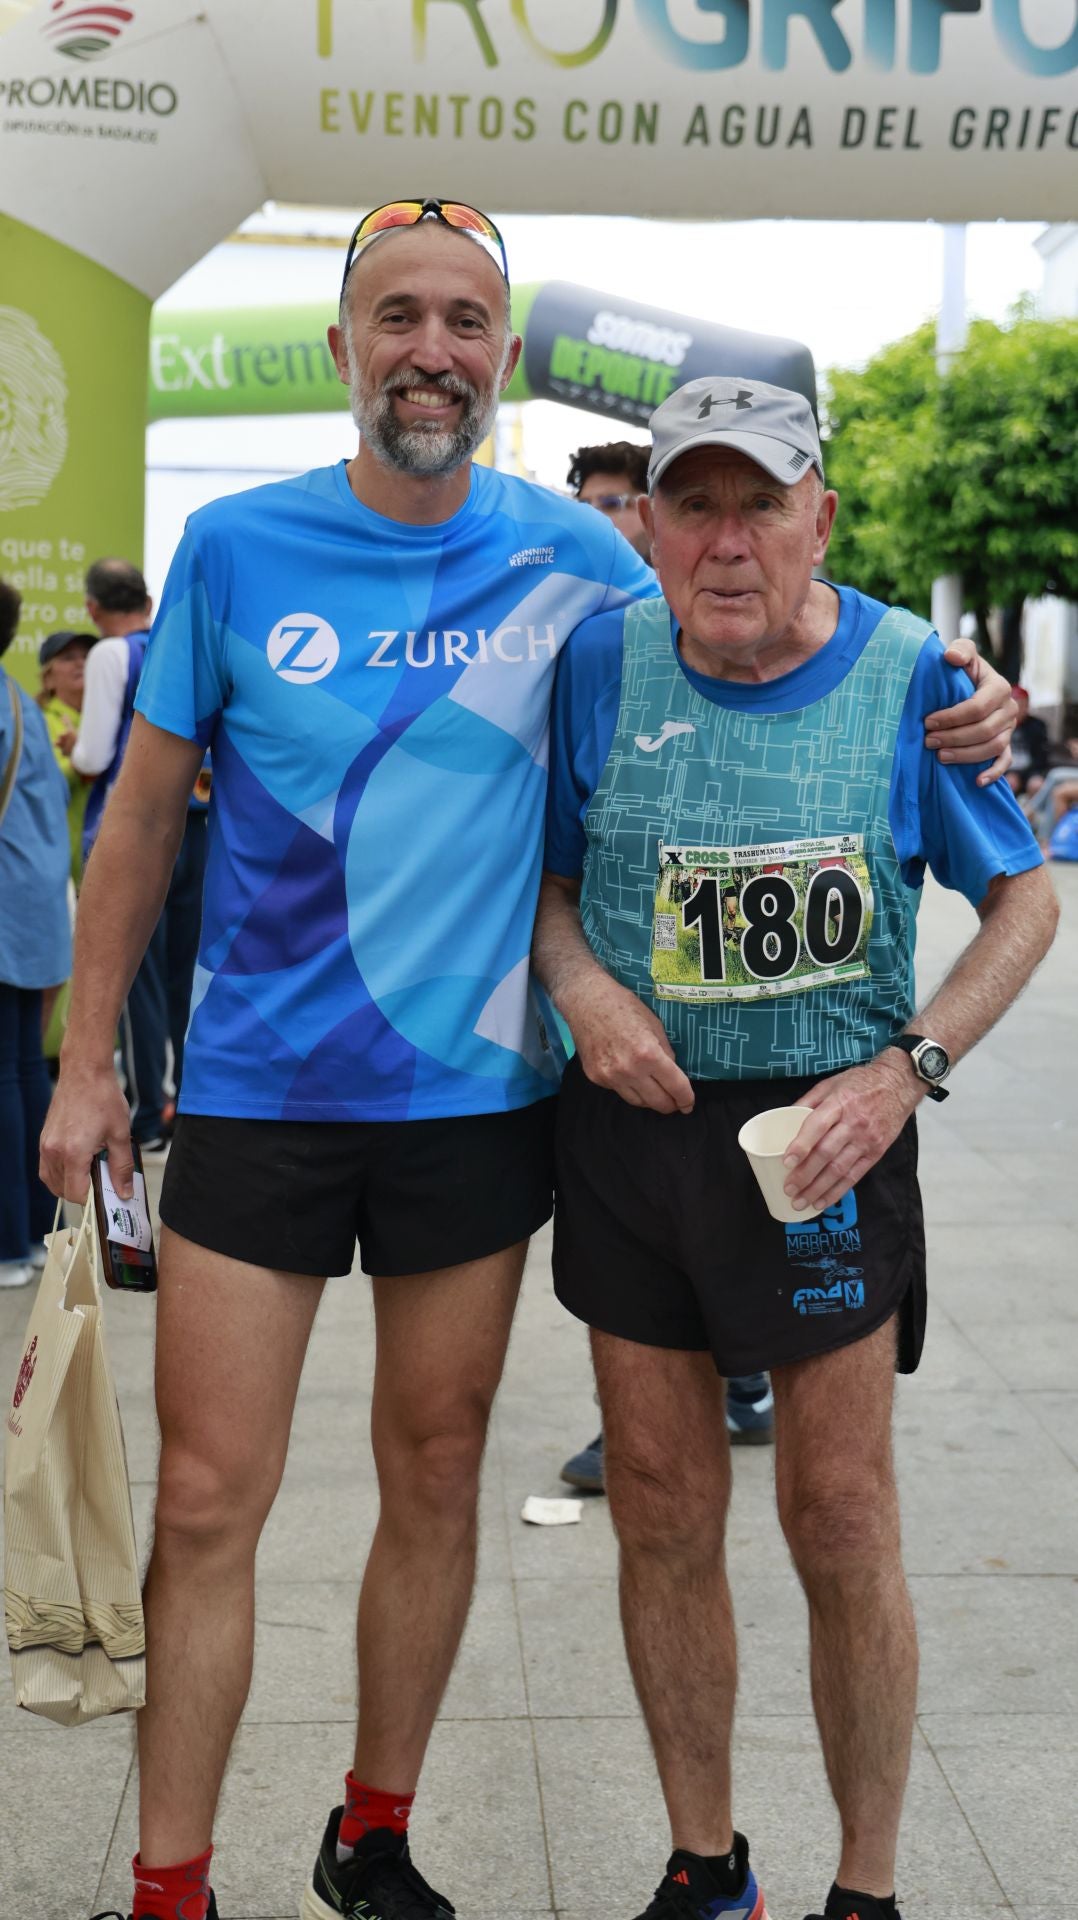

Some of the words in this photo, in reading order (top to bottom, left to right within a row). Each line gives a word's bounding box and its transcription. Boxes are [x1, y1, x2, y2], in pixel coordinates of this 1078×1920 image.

[319, 88, 537, 142] EVENTOS
[563, 99, 658, 146] CON
[683, 104, 814, 149] AGUA
[841, 106, 922, 149] DEL
[150, 332, 333, 392] Extrem
[1, 539, 52, 563] que
[60, 539, 85, 561] te
[509, 554, 555, 567] REPUBLIC
[365, 623, 559, 668] ZURICH
[665, 852, 682, 864] X
[685, 850, 730, 864] CROSS
[733, 846, 786, 858] TRASHUMANCIA
[682, 867, 863, 982] 180
[785, 1187, 858, 1235] 9
[786, 1229, 861, 1250] MARATON
[787, 1243, 861, 1258] POPULAR
